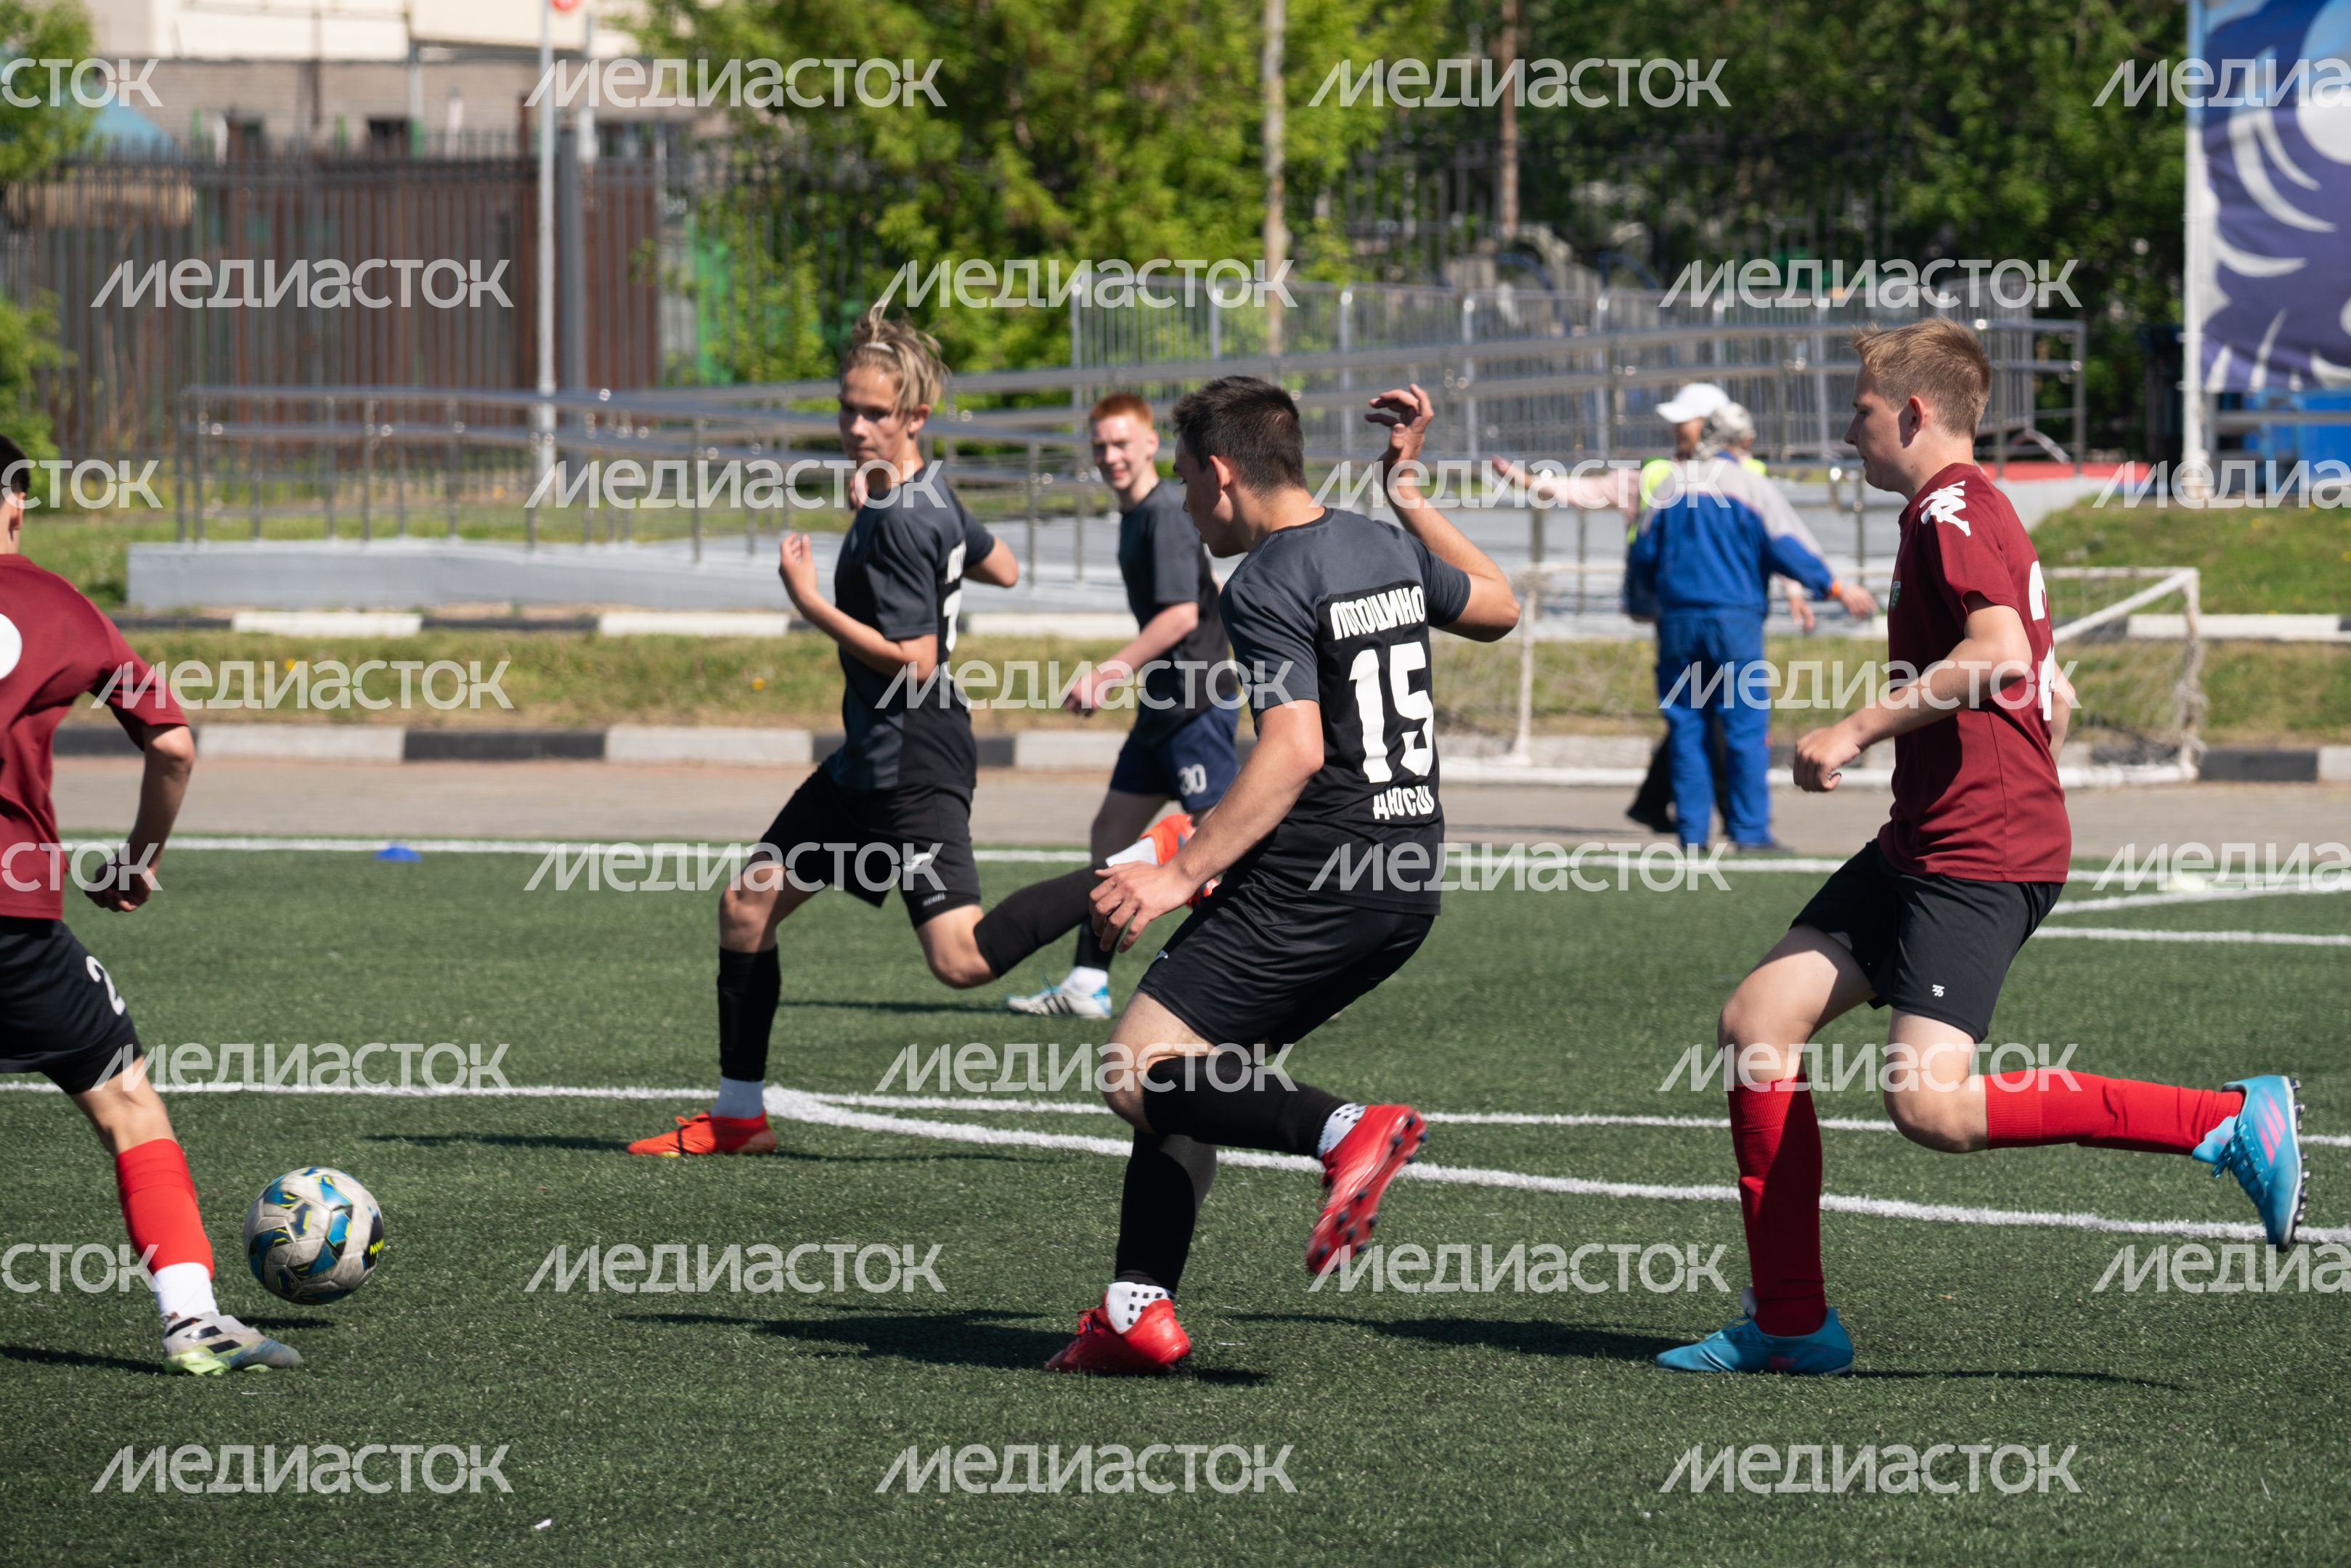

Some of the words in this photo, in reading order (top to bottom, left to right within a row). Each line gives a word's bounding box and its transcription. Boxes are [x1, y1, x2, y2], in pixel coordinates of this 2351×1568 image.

[1349, 642, 1433, 784] 15
[1178, 764, 1207, 796] 30
[1373, 785, 1435, 820] ДЮСШ
[86, 955, 126, 1016] 2
